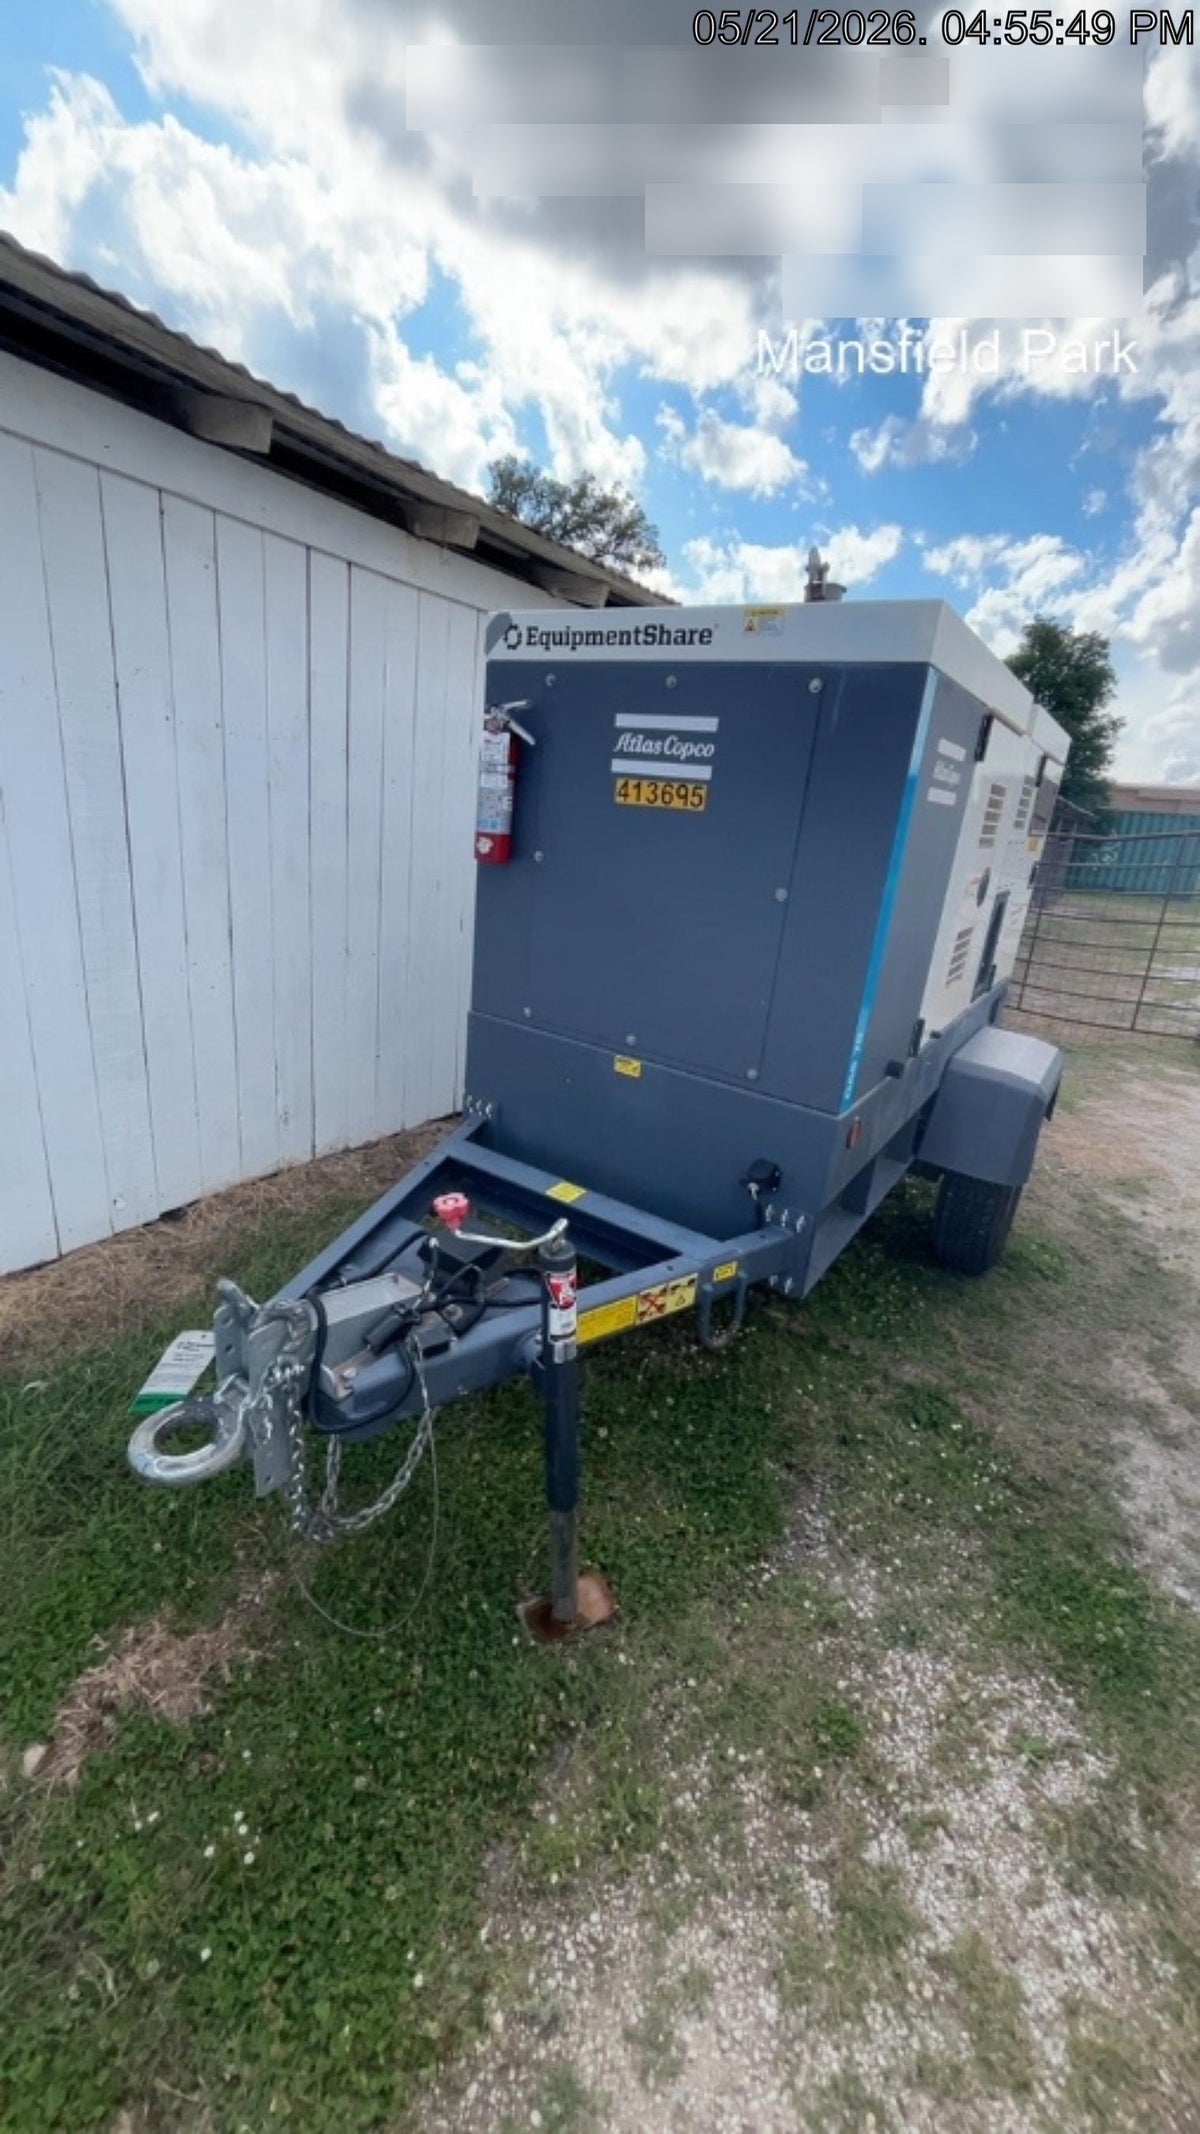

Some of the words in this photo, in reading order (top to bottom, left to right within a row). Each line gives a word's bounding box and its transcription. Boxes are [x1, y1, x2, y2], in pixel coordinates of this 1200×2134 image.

[525, 623, 713, 651] EquipmentShare
[613, 732, 663, 755] Atlas
[663, 734, 715, 761] Copco
[618, 779, 704, 808] 413695
